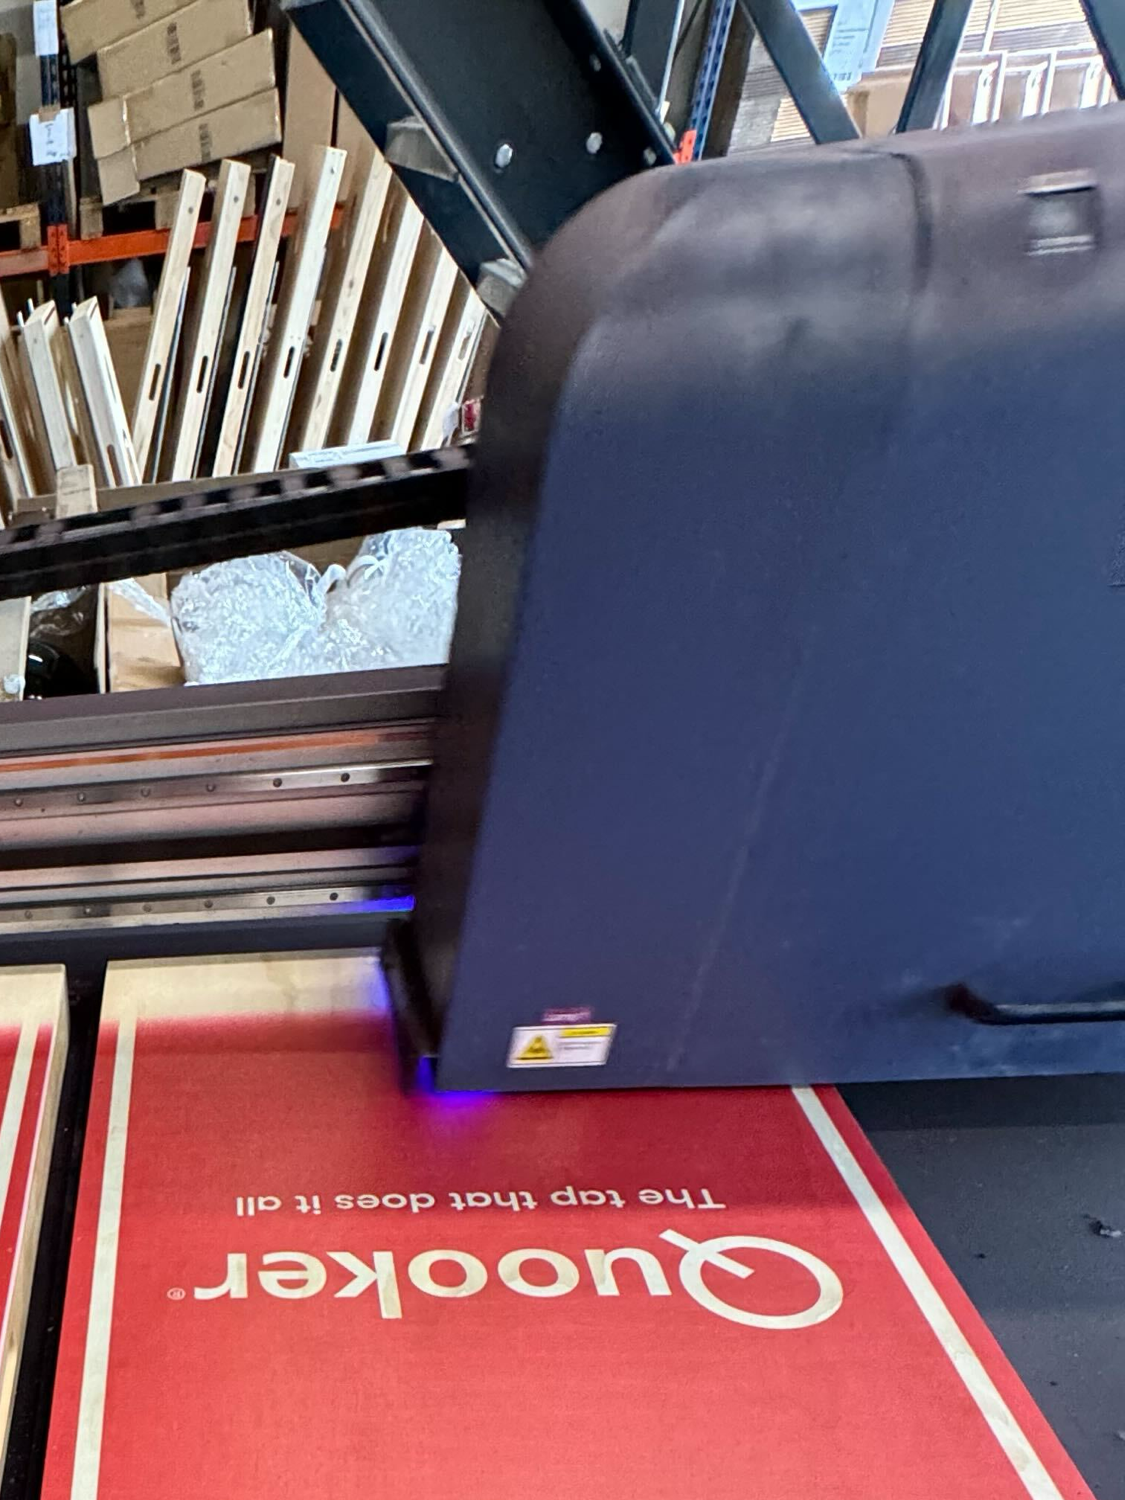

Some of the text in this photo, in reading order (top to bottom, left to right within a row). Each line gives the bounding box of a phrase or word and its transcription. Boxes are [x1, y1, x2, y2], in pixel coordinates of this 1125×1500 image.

[236, 1185, 726, 1217] The tap that does it all
[193, 1228, 844, 1330] Quooker
